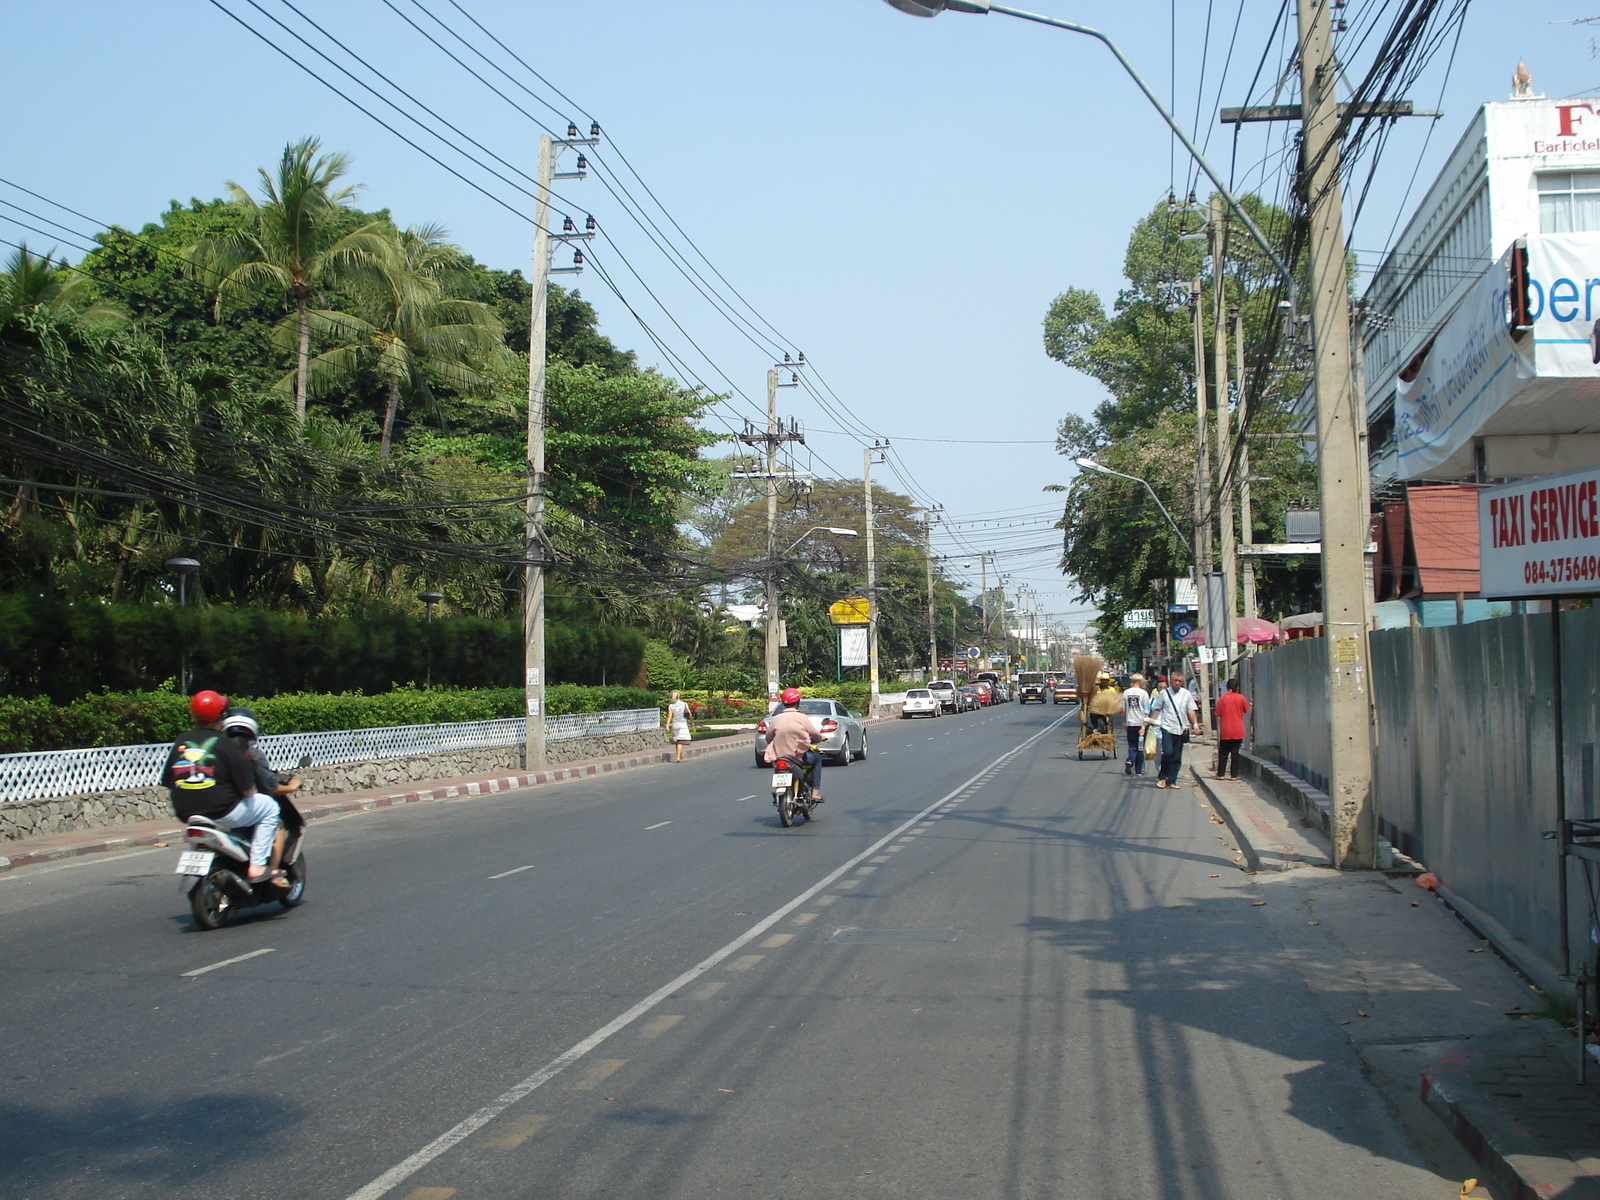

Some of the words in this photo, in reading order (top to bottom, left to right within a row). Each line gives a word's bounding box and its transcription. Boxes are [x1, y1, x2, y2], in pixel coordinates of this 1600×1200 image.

[1490, 494, 1526, 548] TAXI
[1530, 480, 1599, 544] SERVICE
[1524, 555, 1600, 584] 084-375649
